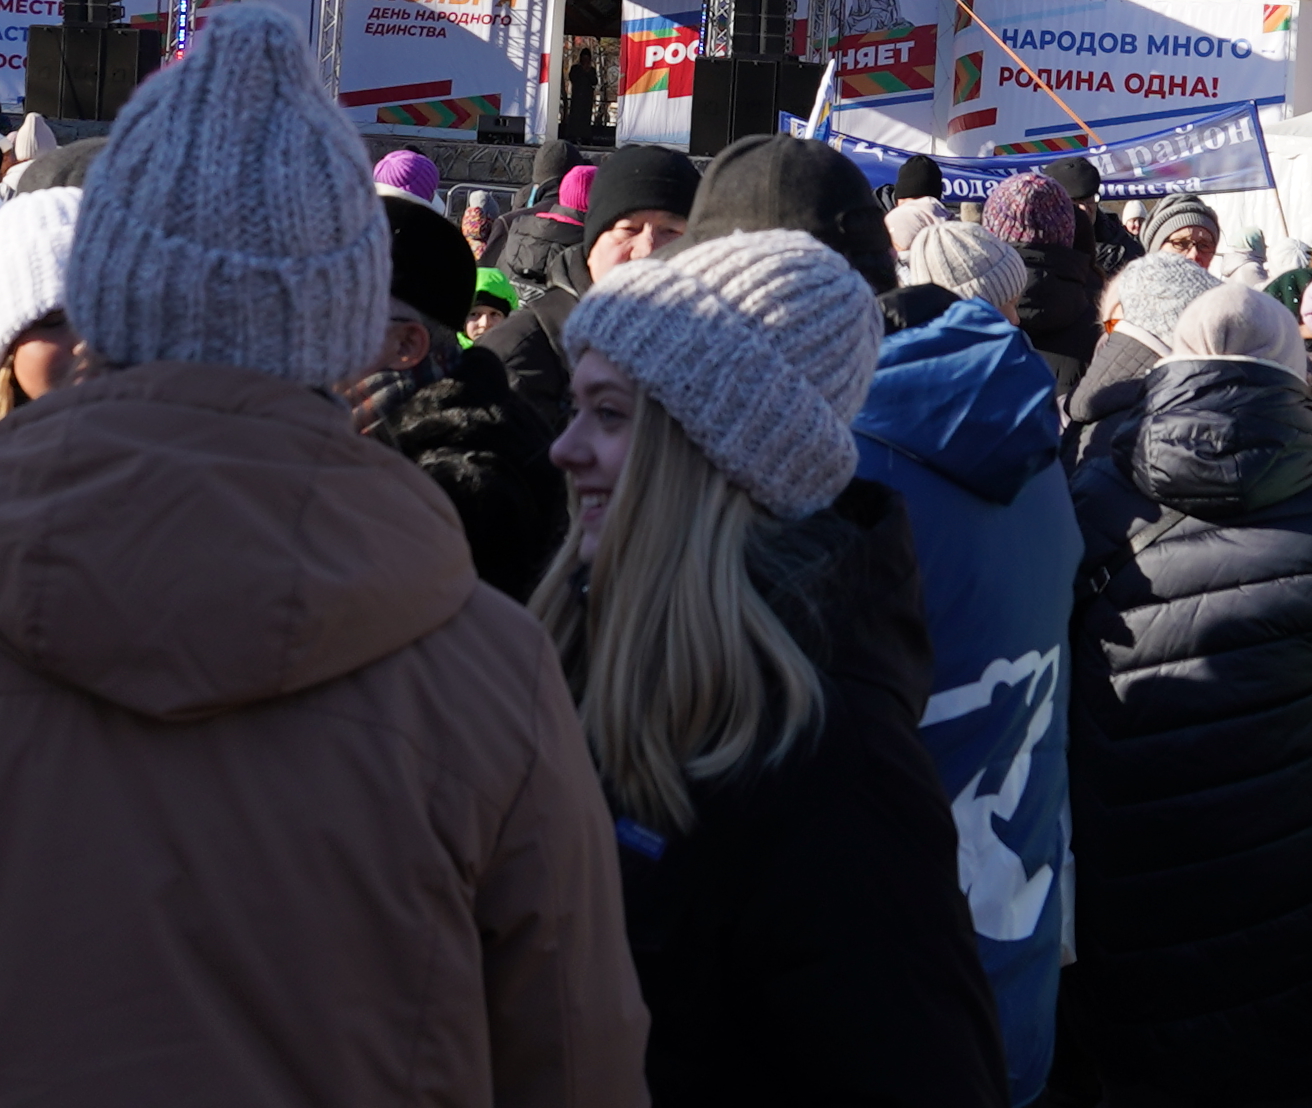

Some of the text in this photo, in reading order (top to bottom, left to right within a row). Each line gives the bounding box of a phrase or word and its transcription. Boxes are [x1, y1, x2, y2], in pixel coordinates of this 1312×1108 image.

[364, 22, 448, 39] ЕДИНСТВА
[368, 7, 513, 27] ДЕНЬ НАРОДНОГО
[1001, 28, 1138, 56] НАРОДОВ
[1147, 34, 1253, 59] МНОГО
[999, 66, 1220, 99] РОДИНА ОДНА!
[1124, 115, 1255, 178] район
